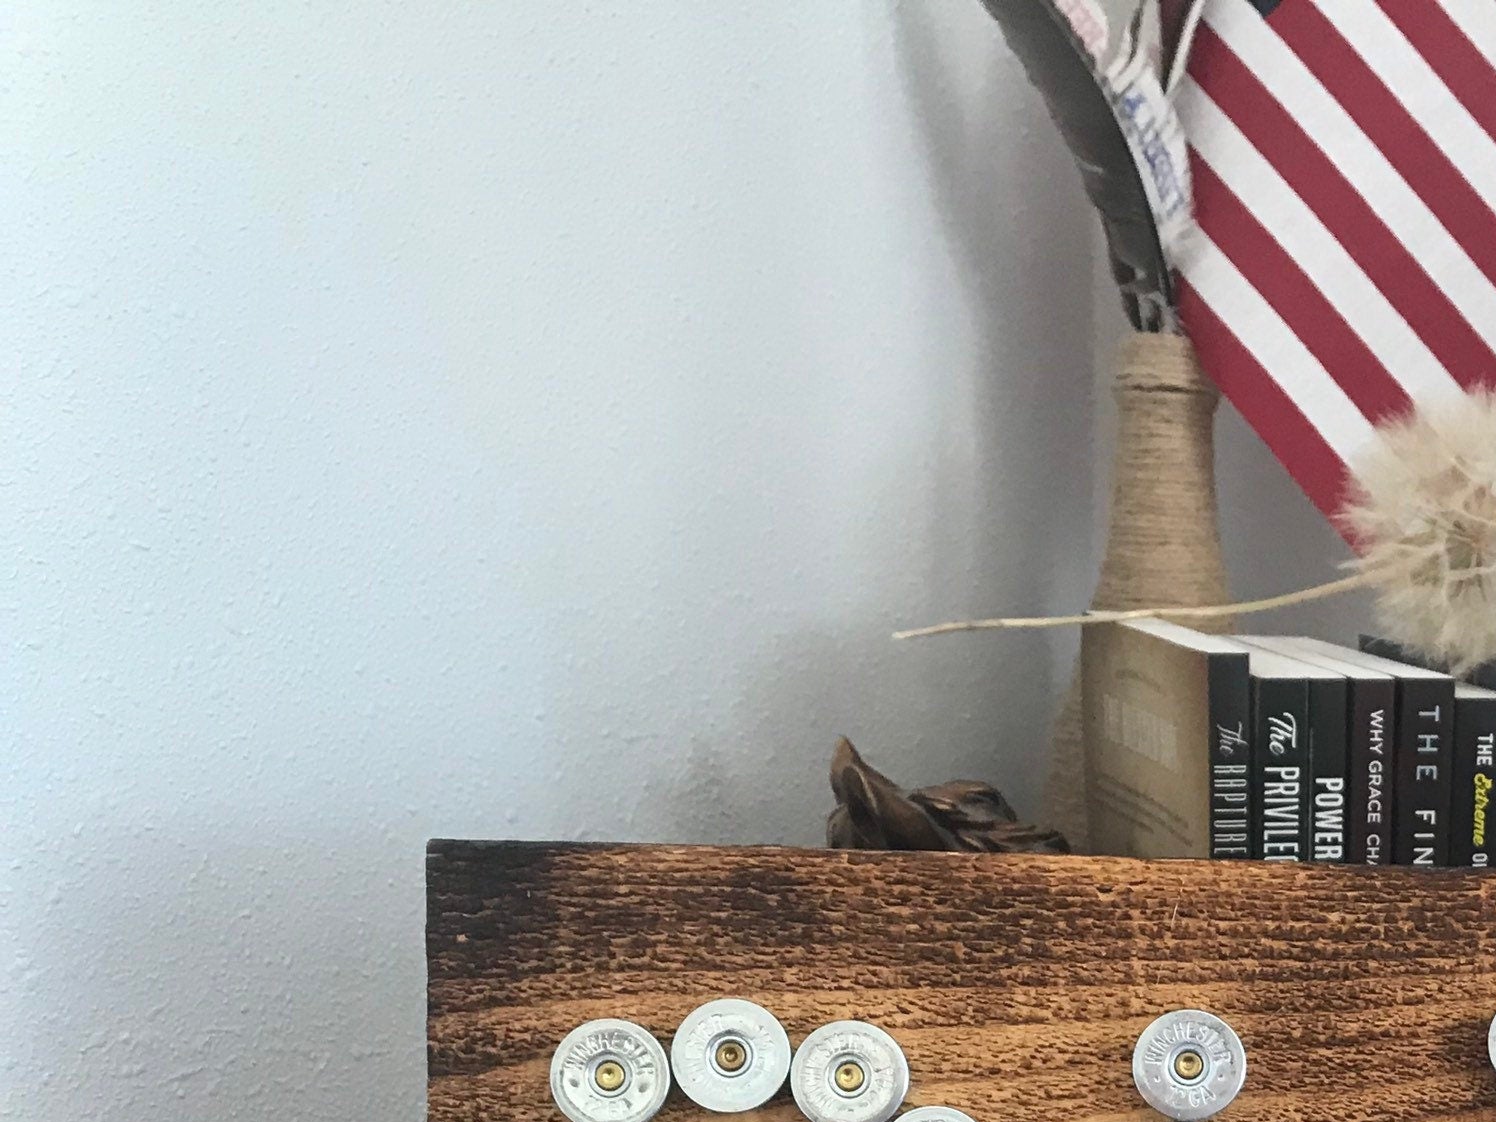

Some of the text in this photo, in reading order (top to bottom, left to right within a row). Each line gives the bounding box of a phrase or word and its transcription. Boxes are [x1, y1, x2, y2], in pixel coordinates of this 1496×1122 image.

[1268, 711, 1298, 756] The
[1369, 709, 1385, 755] WHY
[1475, 733, 1494, 767] THE
[1213, 721, 1247, 854] The RAPTURE
[1314, 777, 1344, 860] POWER
[1366, 759, 1383, 824] GRACE
[1412, 704, 1440, 866] THE FIN
[1471, 772, 1494, 848] Extreme
